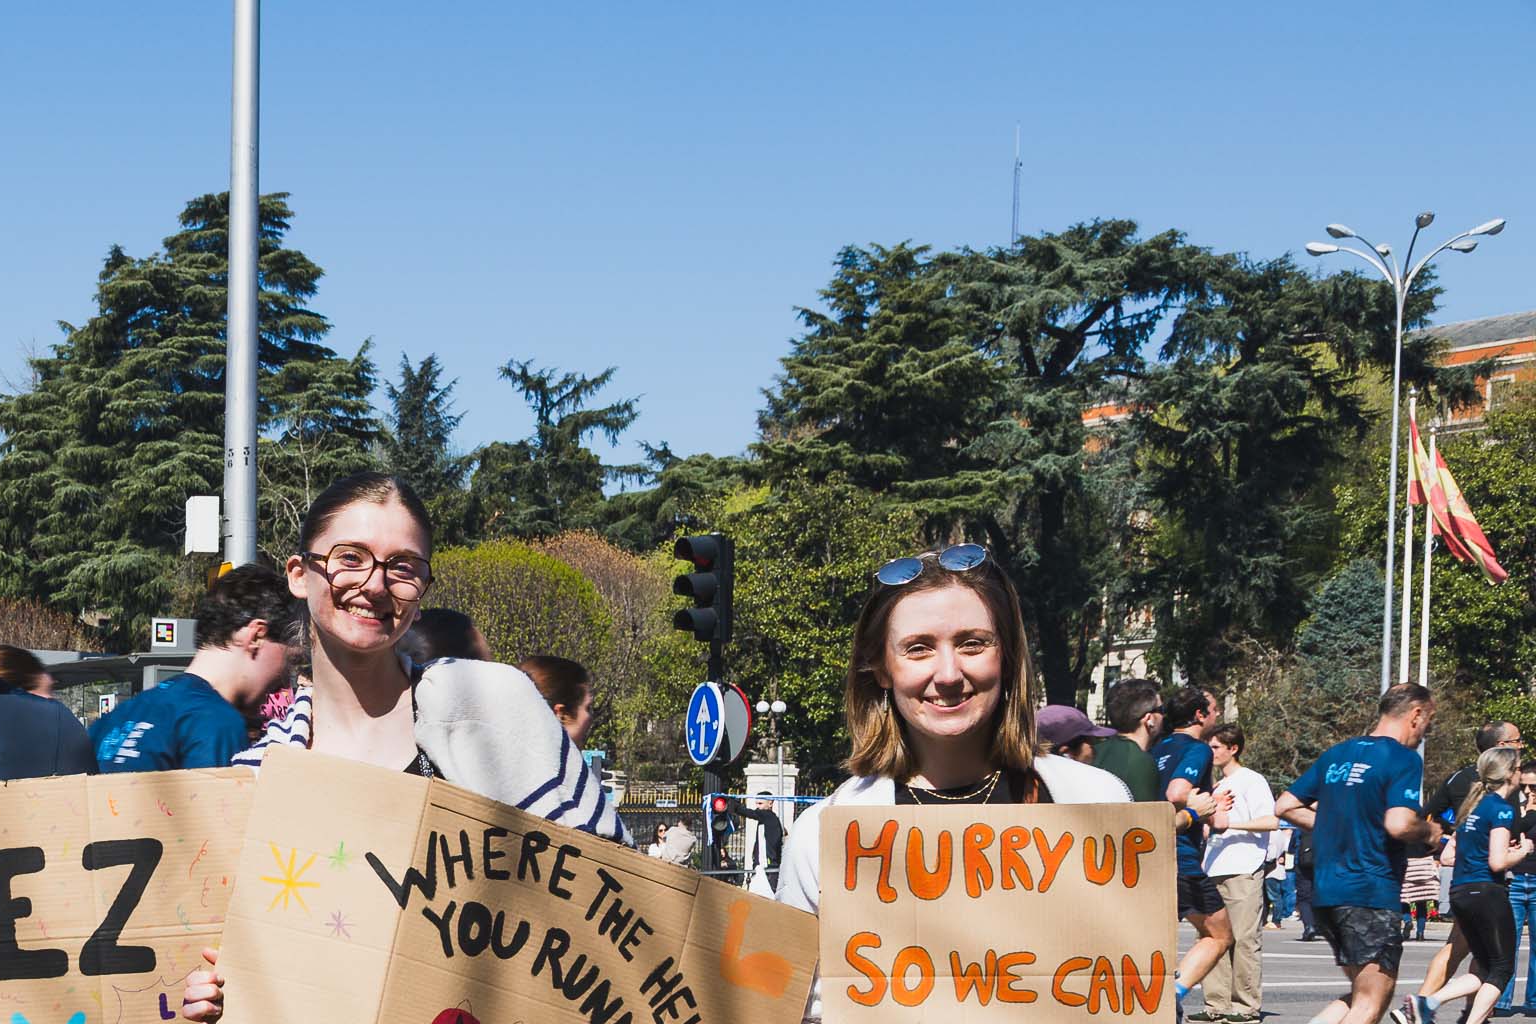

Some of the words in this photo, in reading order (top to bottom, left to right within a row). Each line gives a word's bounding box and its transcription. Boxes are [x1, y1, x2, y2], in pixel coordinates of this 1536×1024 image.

[365, 827, 582, 909] WHERE
[583, 867, 653, 963] THE
[844, 819, 1075, 904] HURRY
[1082, 827, 1157, 889] UP
[422, 900, 530, 959] YOU
[844, 931, 936, 1008] SO
[949, 949, 1039, 1007] WE
[1051, 950, 1167, 1016] CAN
